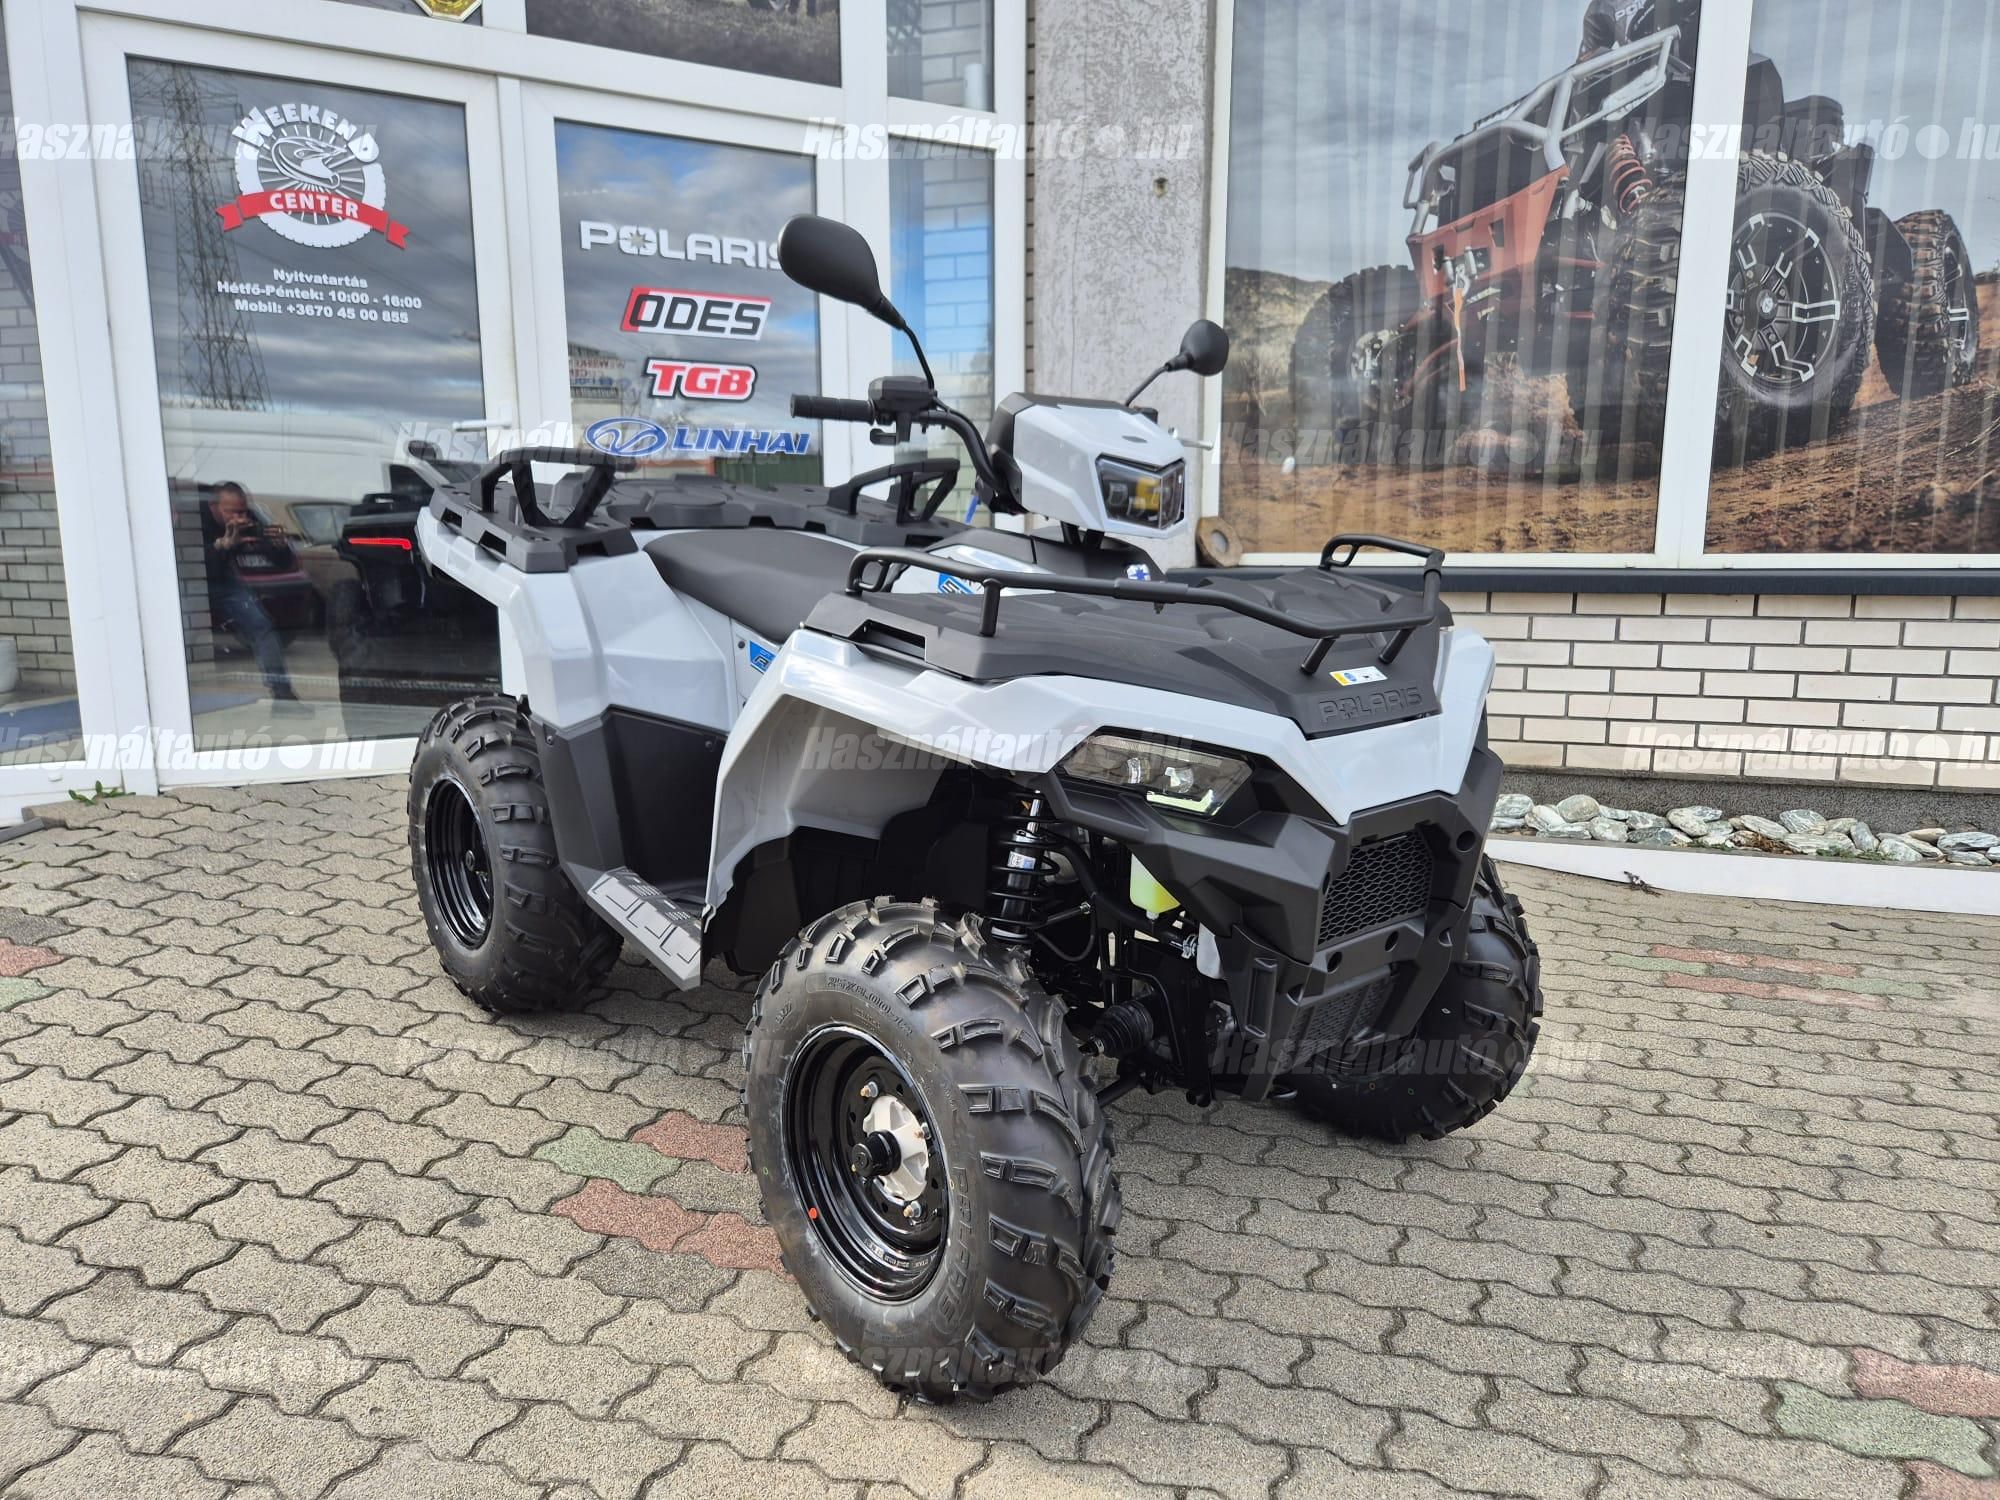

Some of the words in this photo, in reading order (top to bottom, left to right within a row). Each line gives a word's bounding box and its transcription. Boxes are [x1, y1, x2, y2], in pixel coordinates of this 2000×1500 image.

[232, 103, 379, 162] WEEKEND
[269, 192, 359, 218] CENTER
[273, 269, 368, 288] Nyitvatartás
[235, 299, 282, 314] Mobil:
[286, 305, 333, 318] +3670
[337, 308, 356, 320] 45
[360, 309, 378, 321] 00
[328, 290, 369, 305] 10:00
[629, 294, 766, 336] ODES
[649, 360, 755, 398] TGB
[671, 425, 811, 454] LINHAI
[1318, 686, 1423, 723] POLARIS
